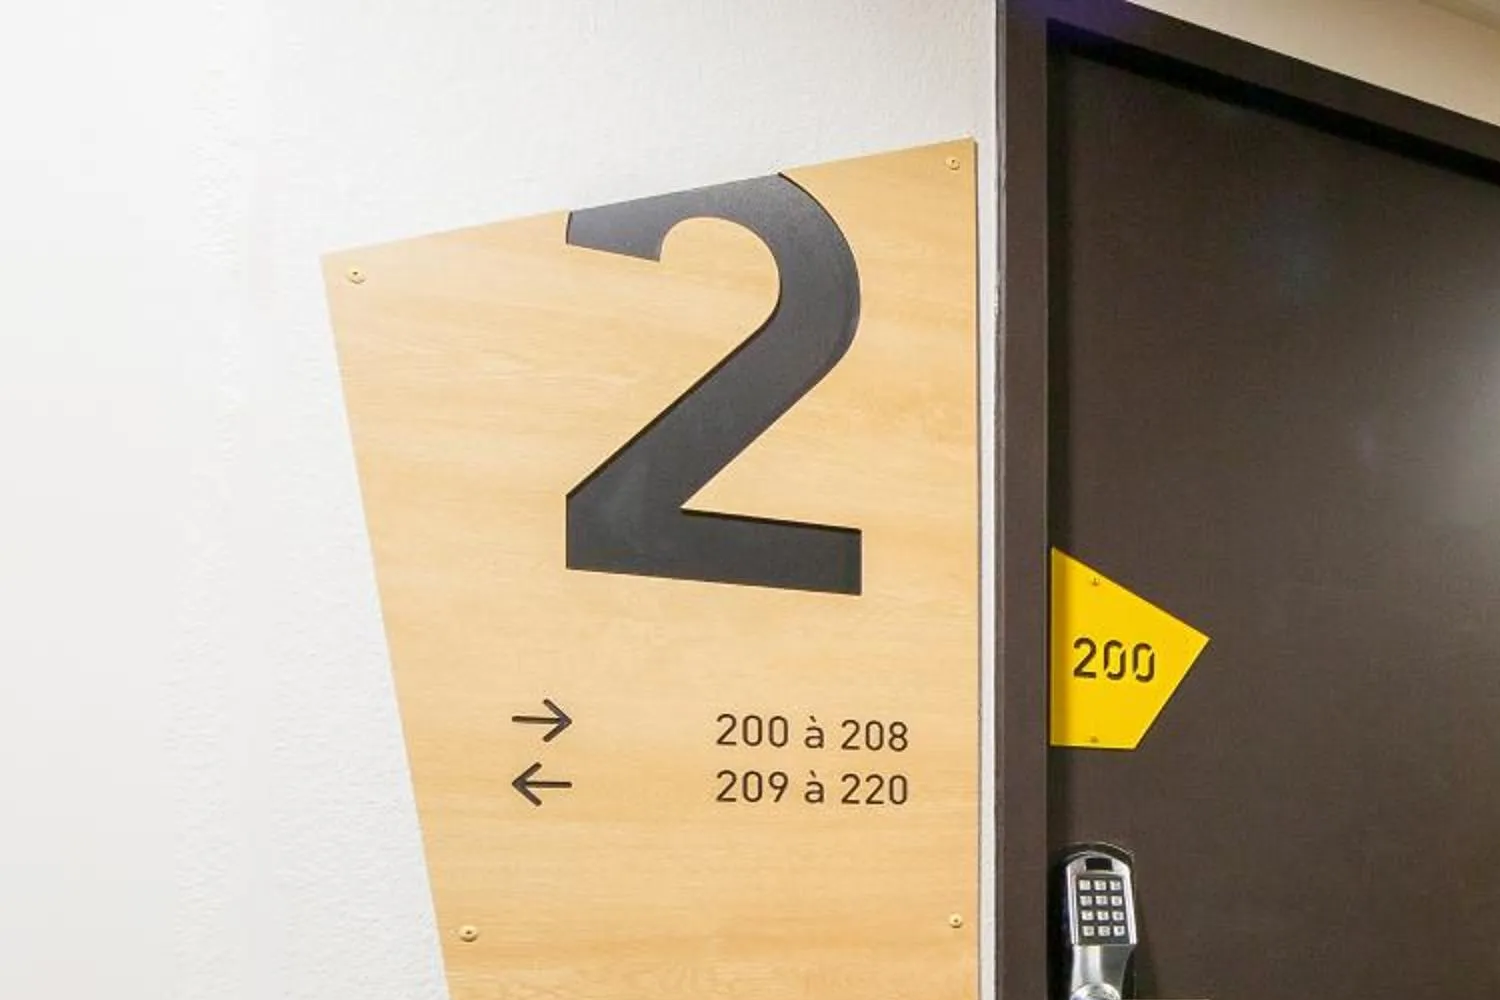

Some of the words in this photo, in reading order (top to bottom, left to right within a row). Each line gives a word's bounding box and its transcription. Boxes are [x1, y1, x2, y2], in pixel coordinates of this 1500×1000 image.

[565, 173, 862, 596] 2
[1073, 638, 1156, 682] 200
[716, 714, 789, 747] 200
[804, 716, 825, 749] à
[841, 720, 908, 753] 208
[716, 770, 789, 803] 209
[804, 770, 825, 804] à
[841, 774, 908, 805] 220
